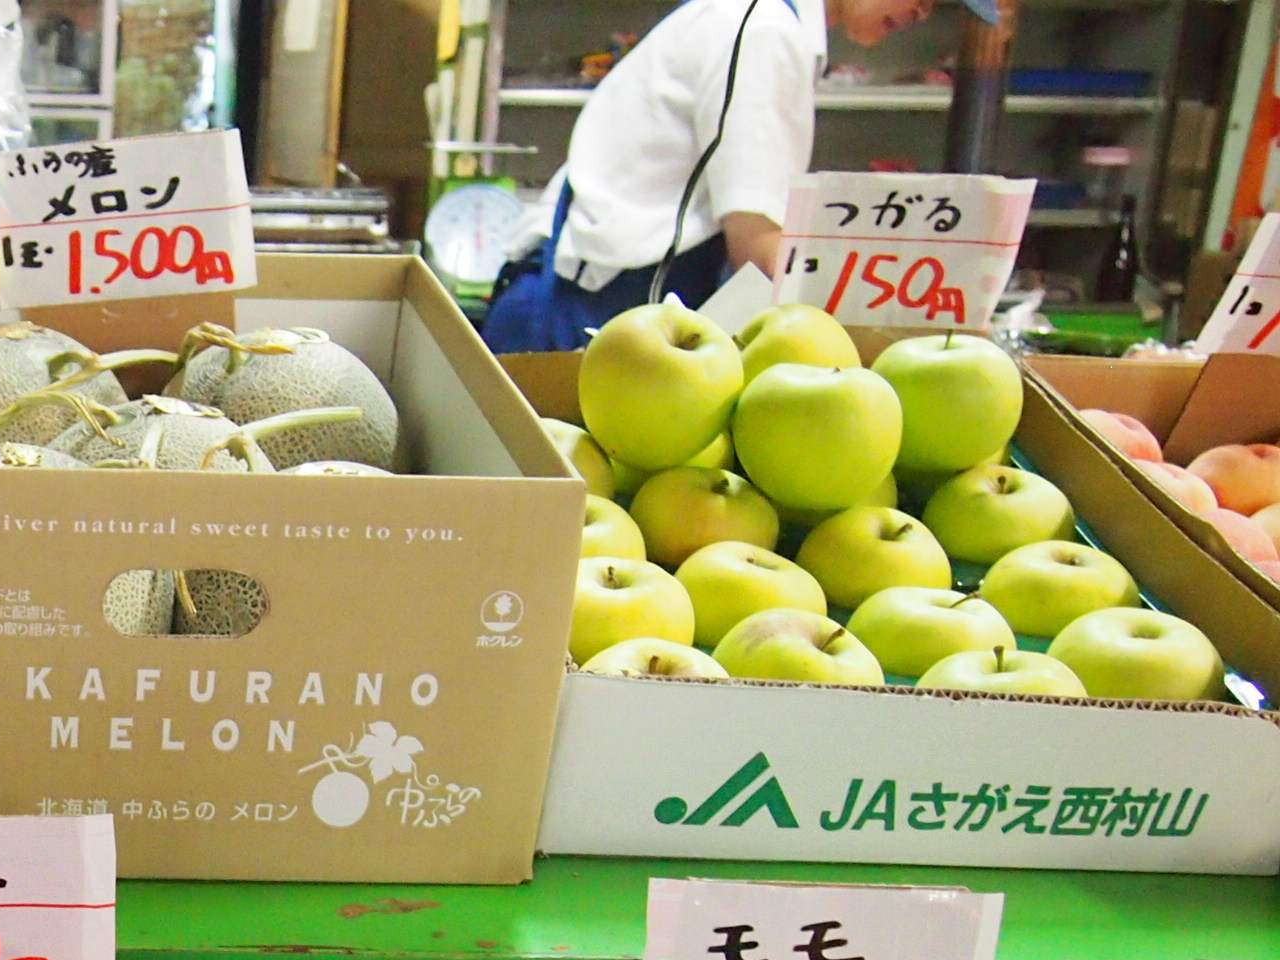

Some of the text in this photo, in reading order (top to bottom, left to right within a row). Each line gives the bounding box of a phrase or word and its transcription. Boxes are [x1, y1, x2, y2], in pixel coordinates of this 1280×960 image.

[41, 176, 180, 222] メロン
[824, 190, 963, 233] つがる
[823, 250, 966, 324] 150円
[72, 516, 178, 535] natural
[190, 521, 270, 538] sweet
[283, 522, 351, 539] taste
[364, 523, 391, 540] to
[404, 526, 464, 545] you.
[475, 634, 524, 648] ホクレン
[49, 715, 296, 752] MELON
[121, 799, 217, 821] 中ふらの
[230, 802, 299, 822] メロン
[819, 778, 1210, 838] JAさがえ西村山
